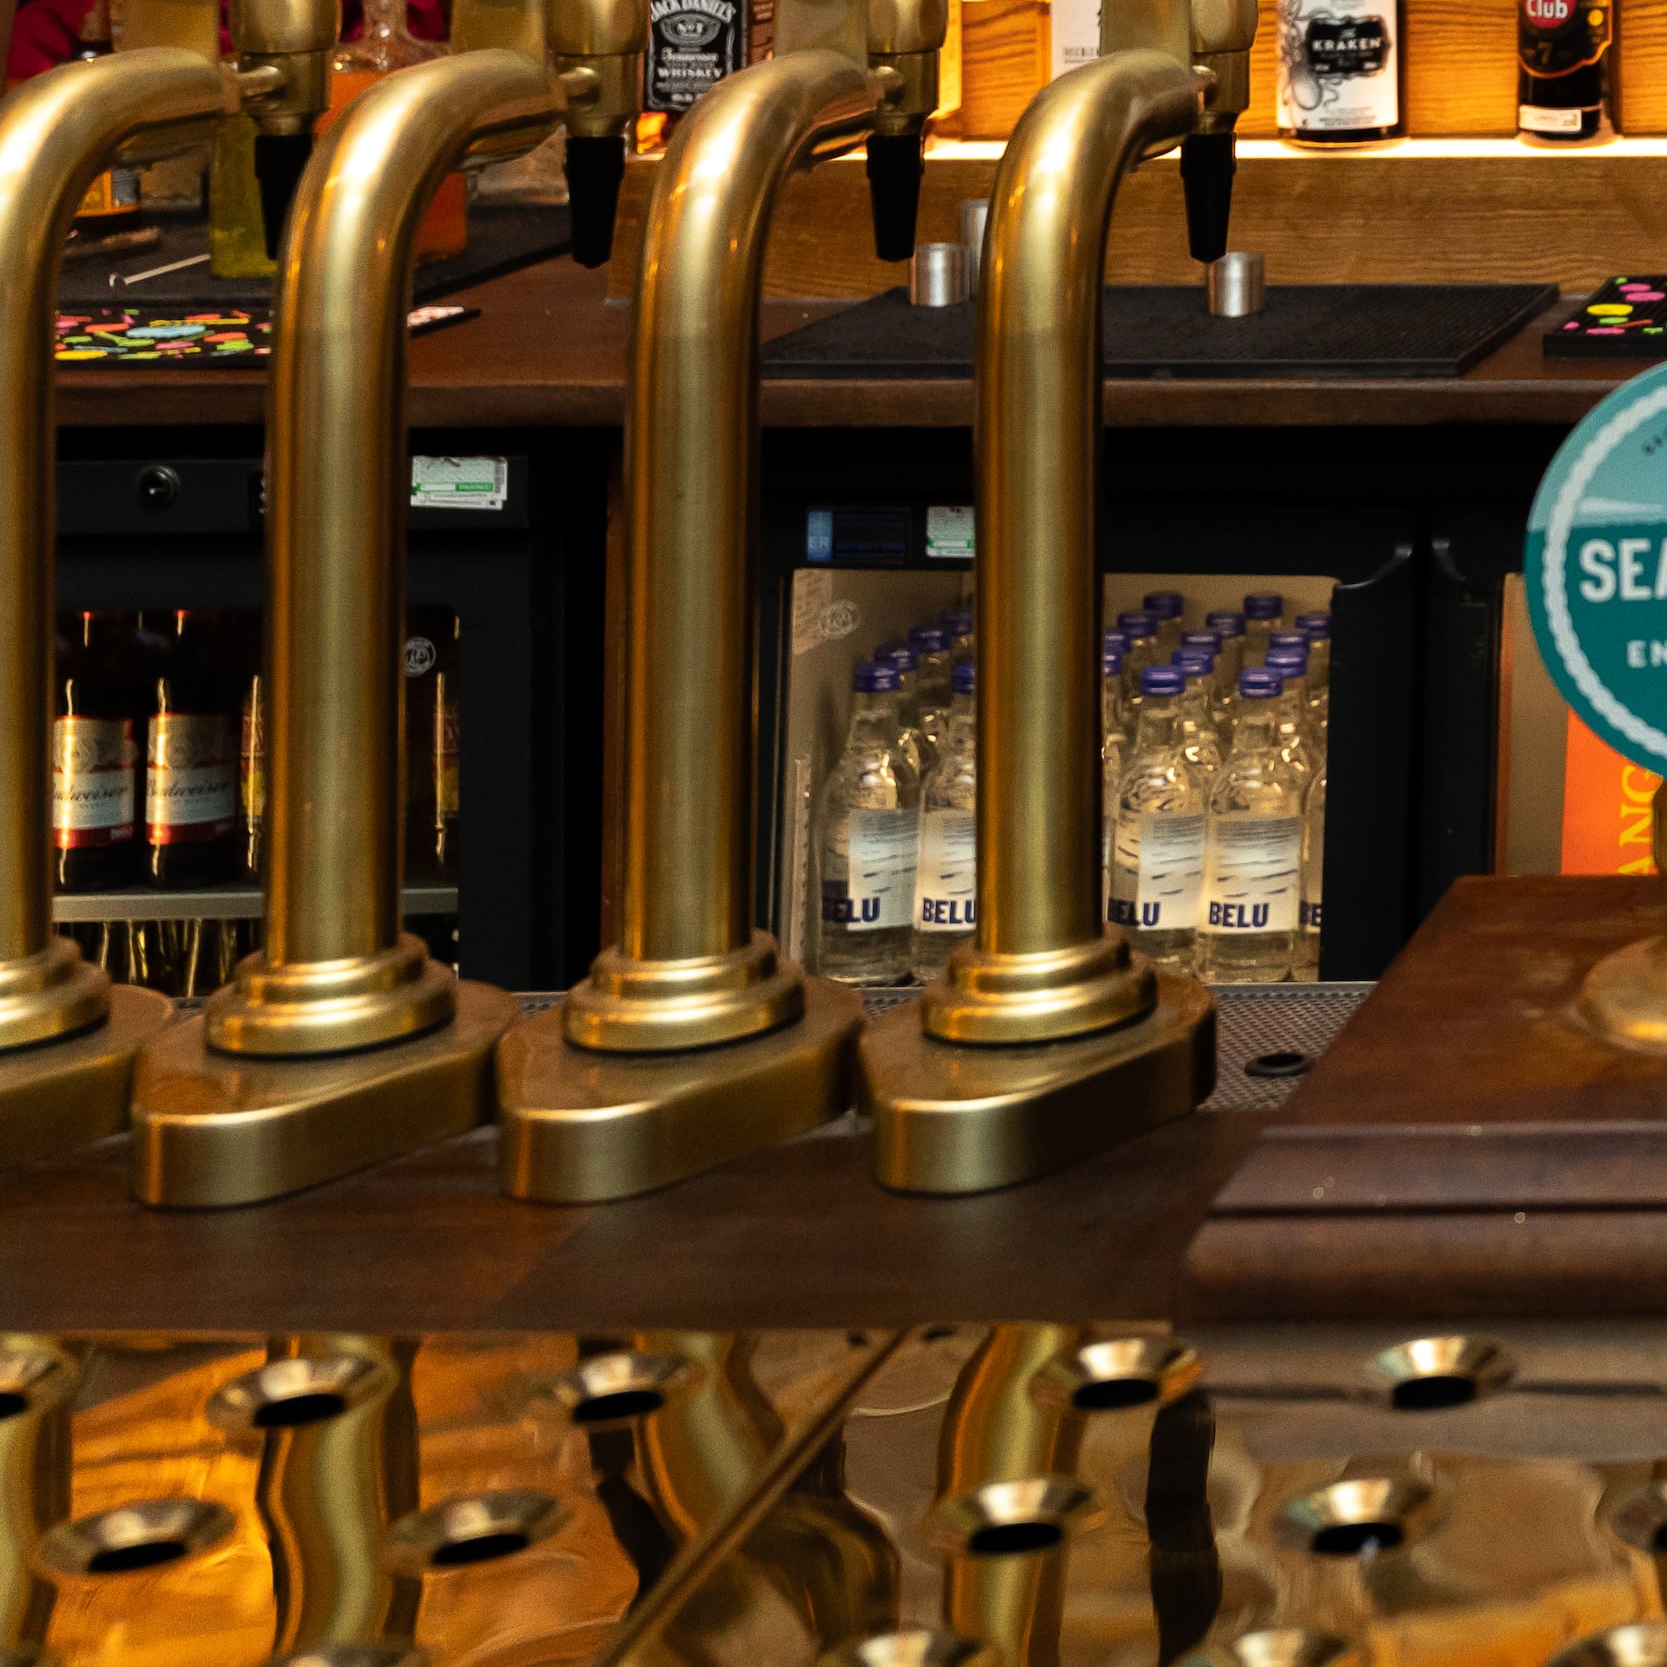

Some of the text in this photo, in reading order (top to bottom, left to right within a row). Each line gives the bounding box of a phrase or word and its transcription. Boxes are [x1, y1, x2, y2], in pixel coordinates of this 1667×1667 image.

[1312, 37, 1381, 53] KRAKEN
[657, 66, 723, 79] WHISKEY
[821, 897, 880, 924] BELU
[1107, 901, 1161, 927] BELU
[1208, 901, 1270, 929] BELU
[1301, 901, 1322, 927] BE
